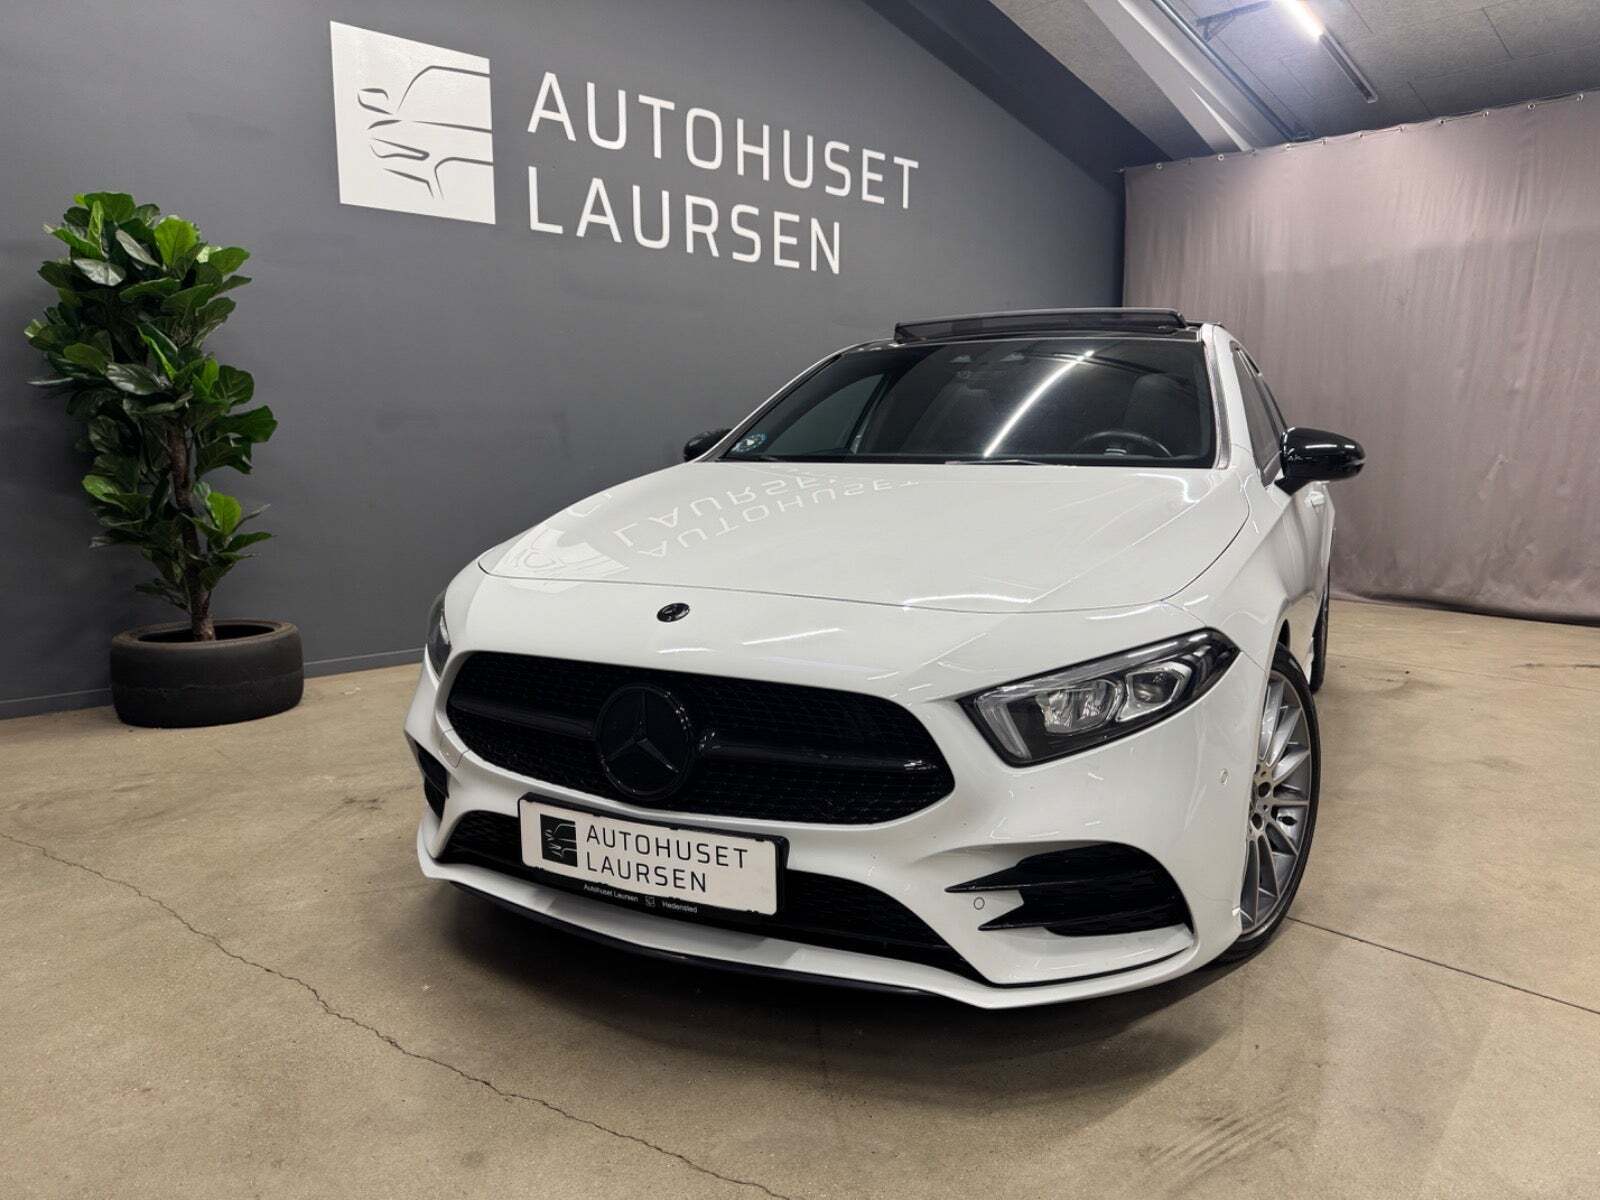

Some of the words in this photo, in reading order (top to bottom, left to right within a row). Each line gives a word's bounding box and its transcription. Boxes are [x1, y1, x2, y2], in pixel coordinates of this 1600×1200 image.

[527, 71, 919, 209] AUTOHUSET
[528, 166, 841, 274] LAURSEN
[586, 824, 748, 869] AUTOHUSET
[586, 852, 707, 893] LAURSEN
[583, 883, 613, 897] Autohuset
[613, 890, 639, 903] Laursen
[661, 901, 698, 913] Hedensted
